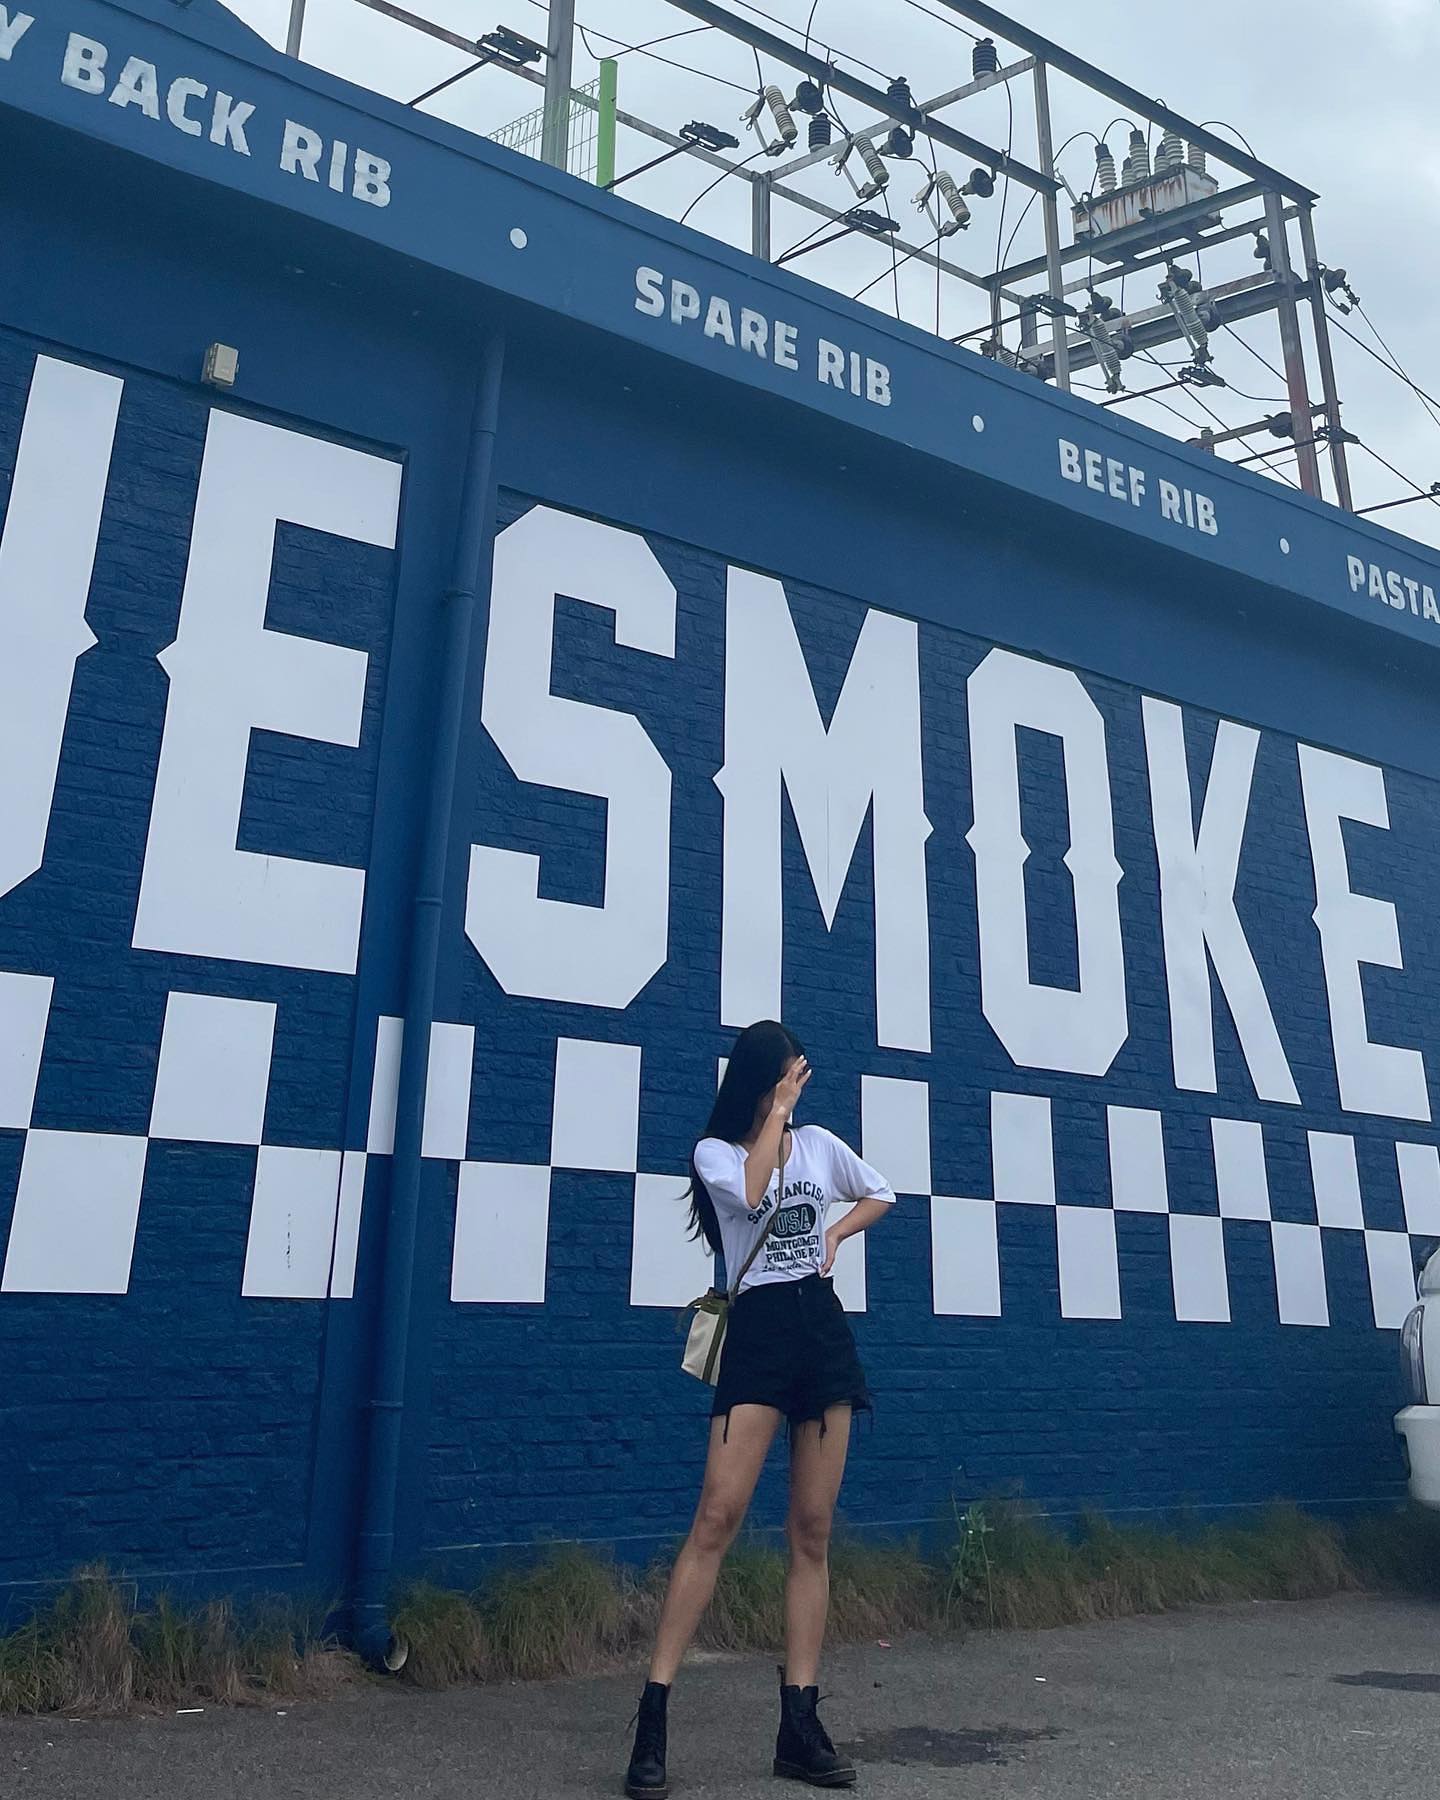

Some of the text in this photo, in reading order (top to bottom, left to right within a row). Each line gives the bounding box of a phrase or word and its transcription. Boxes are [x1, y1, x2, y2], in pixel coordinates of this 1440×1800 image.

[62, 32, 256, 157] BACK
[280, 119, 392, 208] RIB
[635, 266, 799, 370] SPARE
[818, 338, 892, 407] RIB
[1058, 438, 1146, 507] BEEF
[1159, 478, 1218, 537] RIB
[1347, 555, 1440, 624] PASTA
[465, 505, 1432, 1123] SMOKE
[747, 1195, 773, 1224] SAN
[775, 1207, 811, 1235] USA
